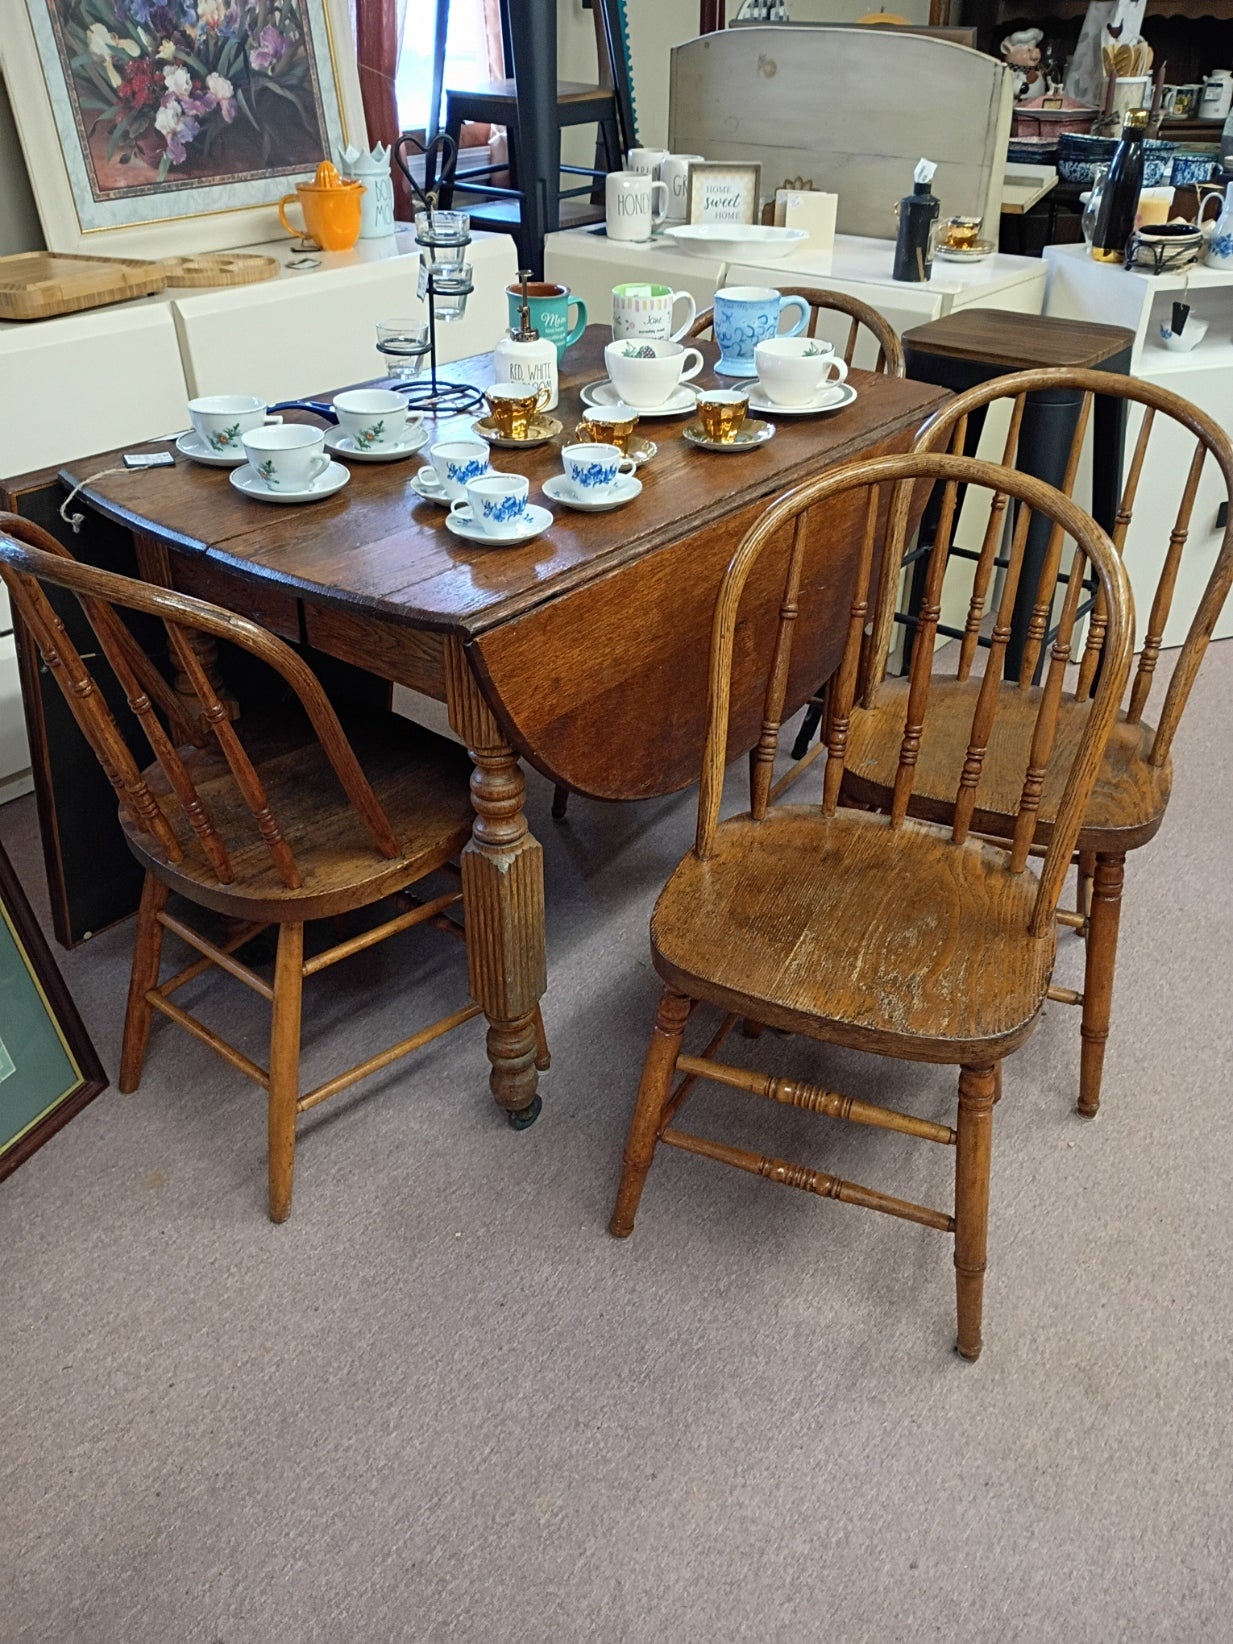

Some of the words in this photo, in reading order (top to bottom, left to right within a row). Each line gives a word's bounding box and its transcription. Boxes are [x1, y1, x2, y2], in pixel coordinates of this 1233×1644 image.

[706, 185, 731, 194] HOME
[704, 193, 741, 210] sweet
[715, 211, 741, 220] HOME
[509, 363, 525, 381] RED,
[527, 362, 552, 381] WHITE
